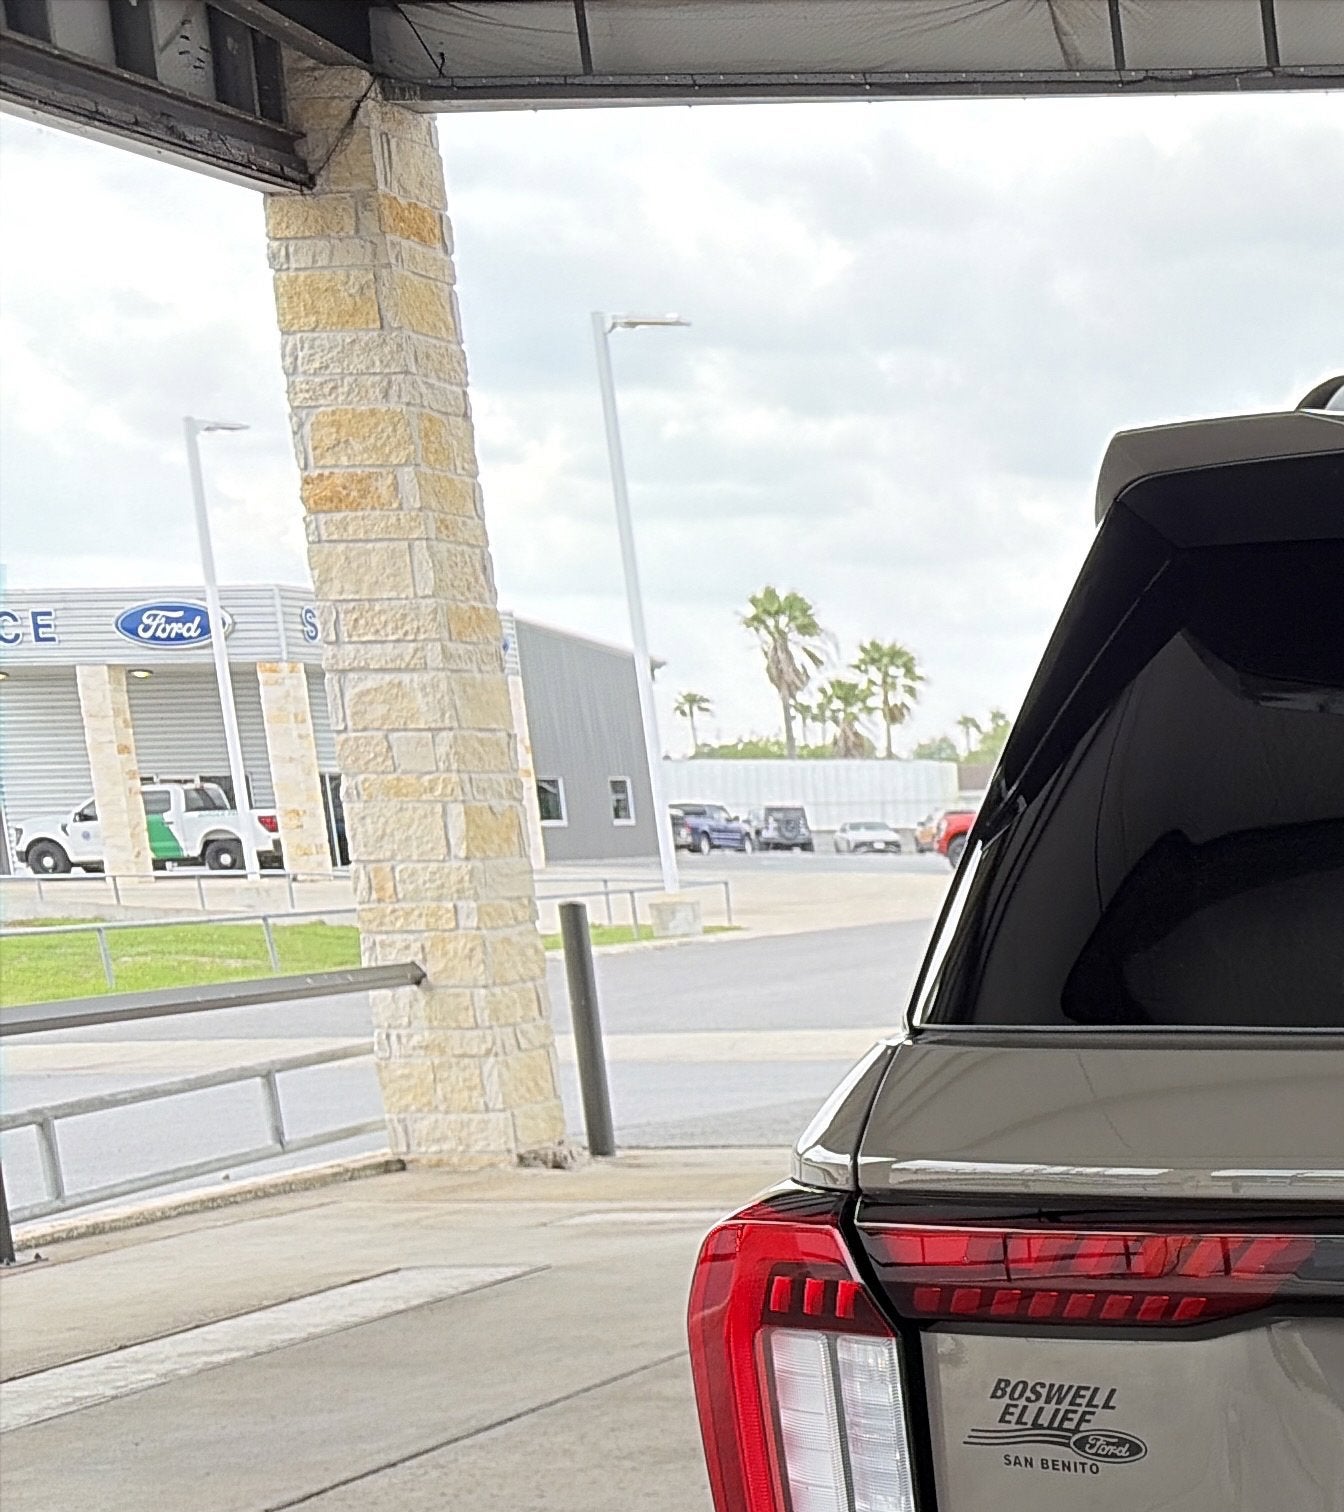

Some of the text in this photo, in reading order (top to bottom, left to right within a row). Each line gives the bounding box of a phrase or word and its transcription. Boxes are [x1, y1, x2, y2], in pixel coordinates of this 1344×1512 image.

[137, 609, 202, 640] Ford
[990, 1377, 1117, 1411] BOSWELL
[998, 1403, 1096, 1431] ELLIFF
[1085, 1435, 1130, 1457] Ford
[1003, 1454, 1100, 1475] SAN BENITO
